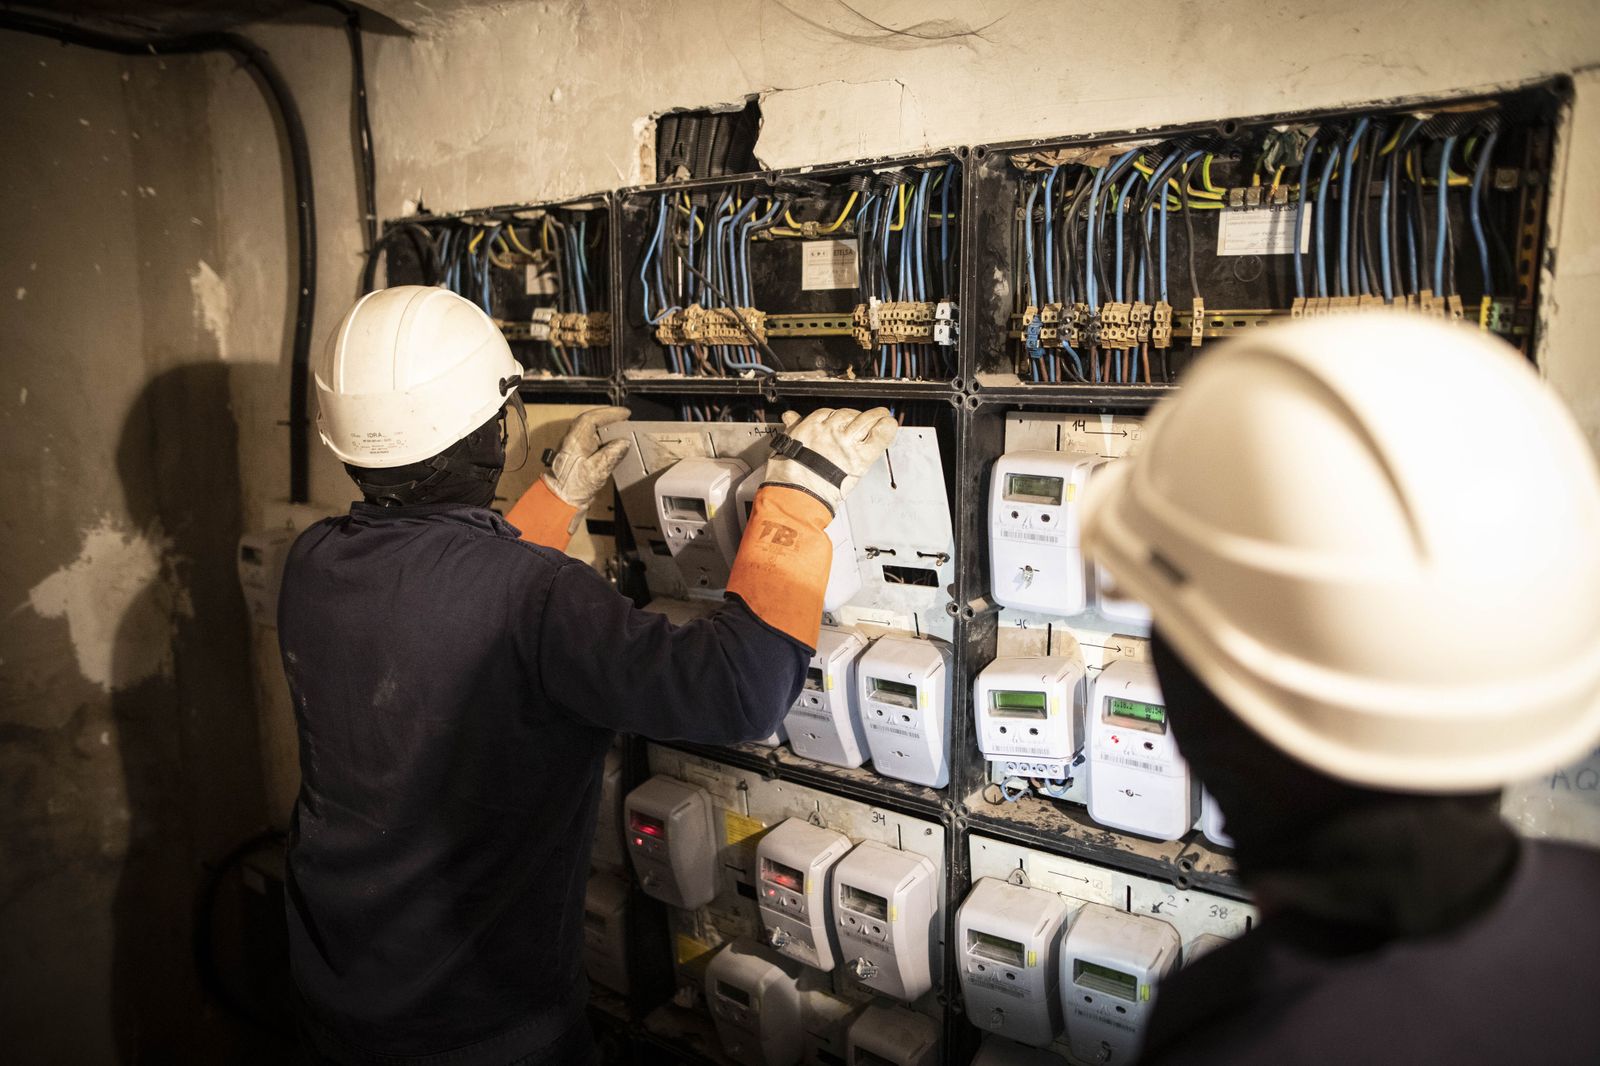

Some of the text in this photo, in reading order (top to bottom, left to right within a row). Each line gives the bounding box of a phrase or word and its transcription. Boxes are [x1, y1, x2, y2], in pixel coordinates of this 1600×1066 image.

[1072, 419, 1086, 432] 14
[759, 520, 798, 547] TB
[871, 811, 886, 827] 34
[1208, 904, 1229, 920] 38
